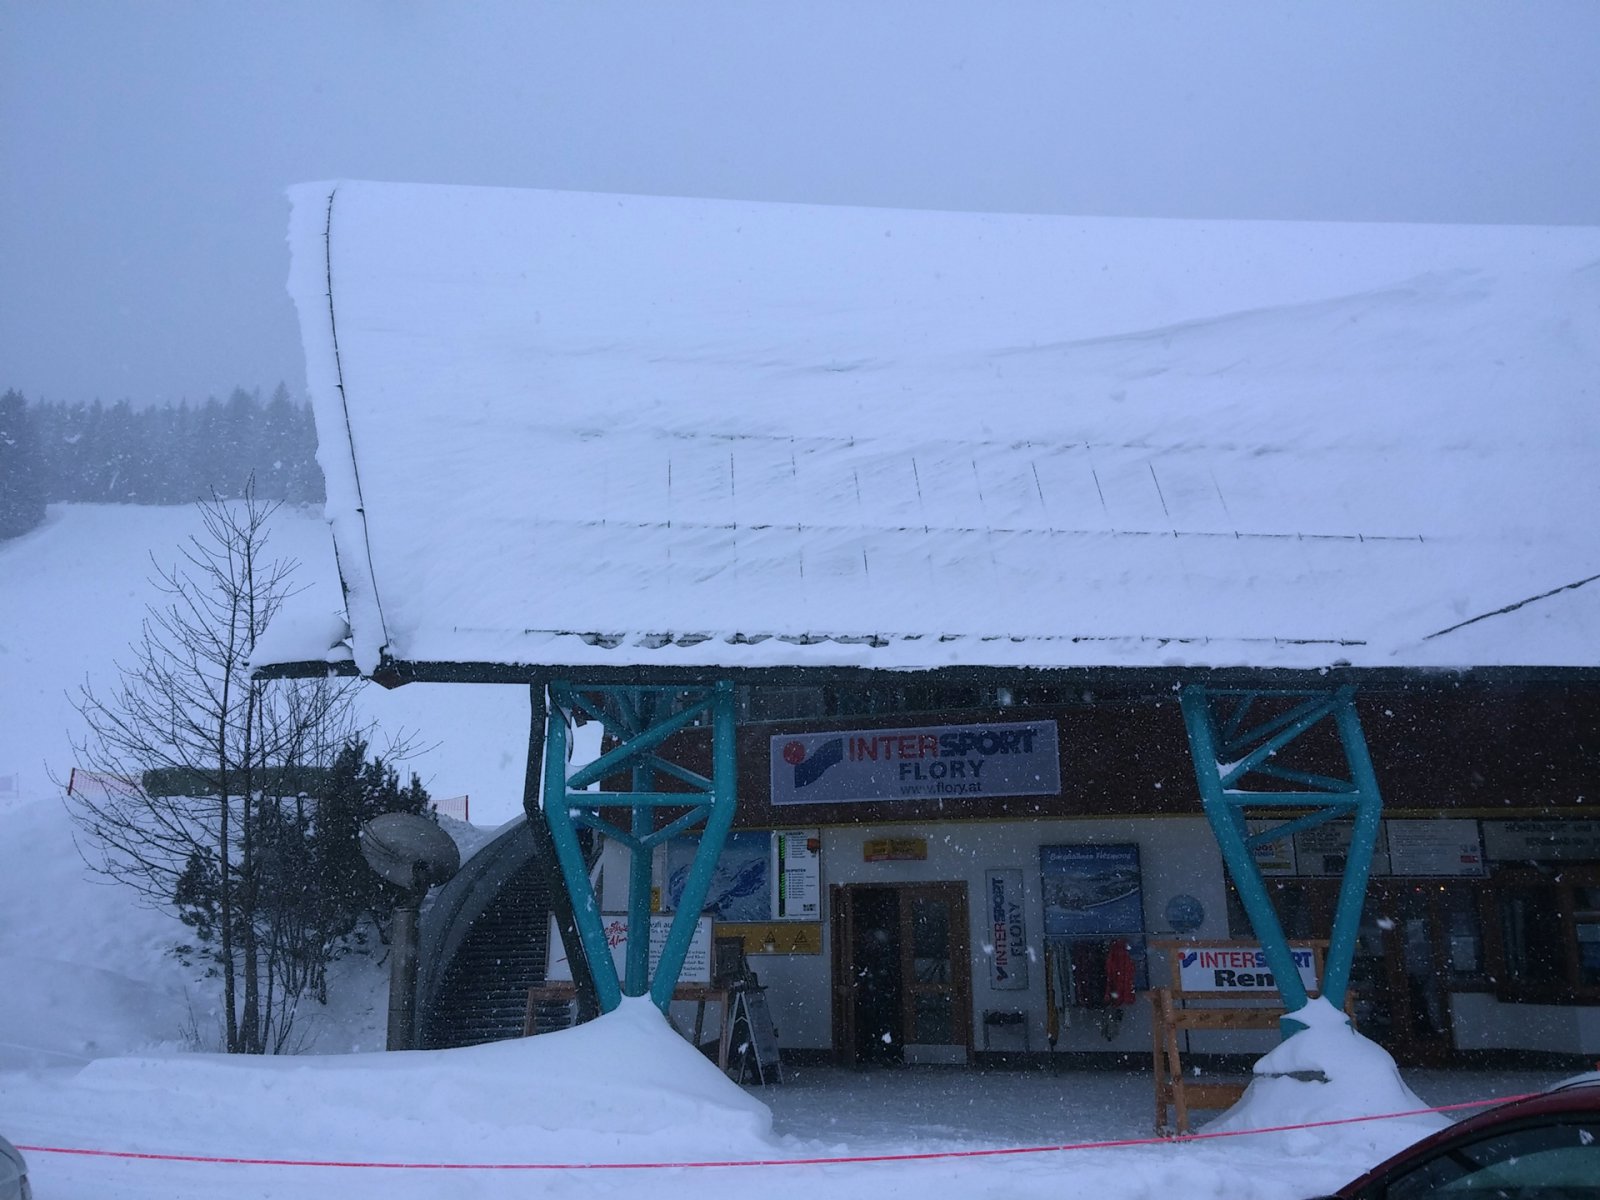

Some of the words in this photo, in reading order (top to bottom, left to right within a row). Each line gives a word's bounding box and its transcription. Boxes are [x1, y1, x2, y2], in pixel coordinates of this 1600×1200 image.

[848, 729, 1037, 762] INTERSPORT
[899, 760, 985, 781] FLORY
[992, 877, 1008, 966] INTERSPORT
[1008, 902, 1023, 957] FLORY
[1199, 951, 1312, 968] INTERSRT
[1214, 969, 1275, 987] Ren
